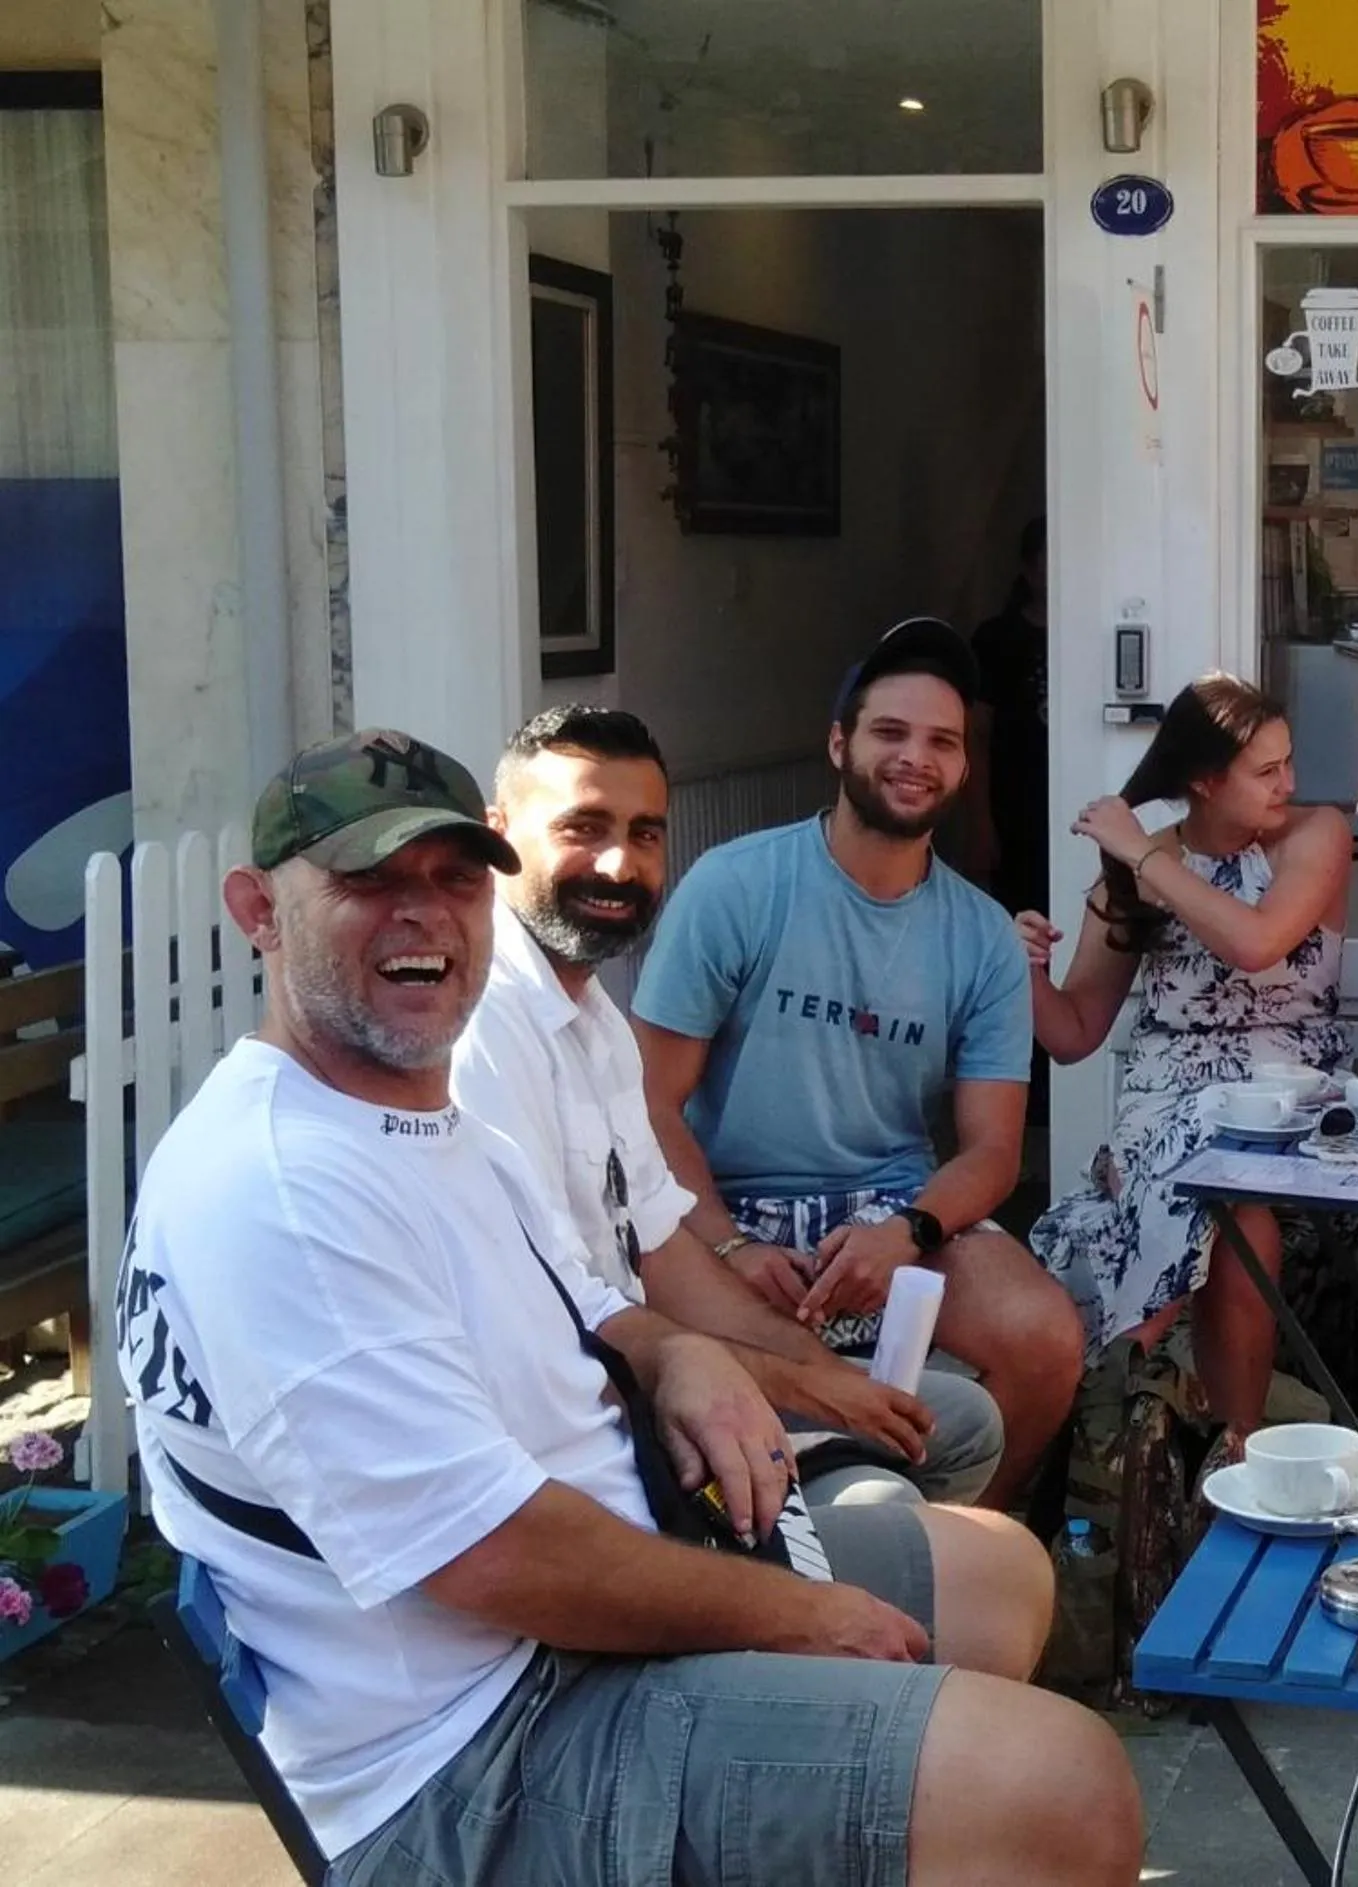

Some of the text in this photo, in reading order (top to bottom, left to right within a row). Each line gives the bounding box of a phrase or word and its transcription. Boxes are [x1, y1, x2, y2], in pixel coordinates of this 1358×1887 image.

[1116, 188, 1147, 215] 20
[1311, 315, 1356, 331] COFFEE
[1317, 343, 1348, 358] TAKE
[380, 1113, 440, 1136] Palm
